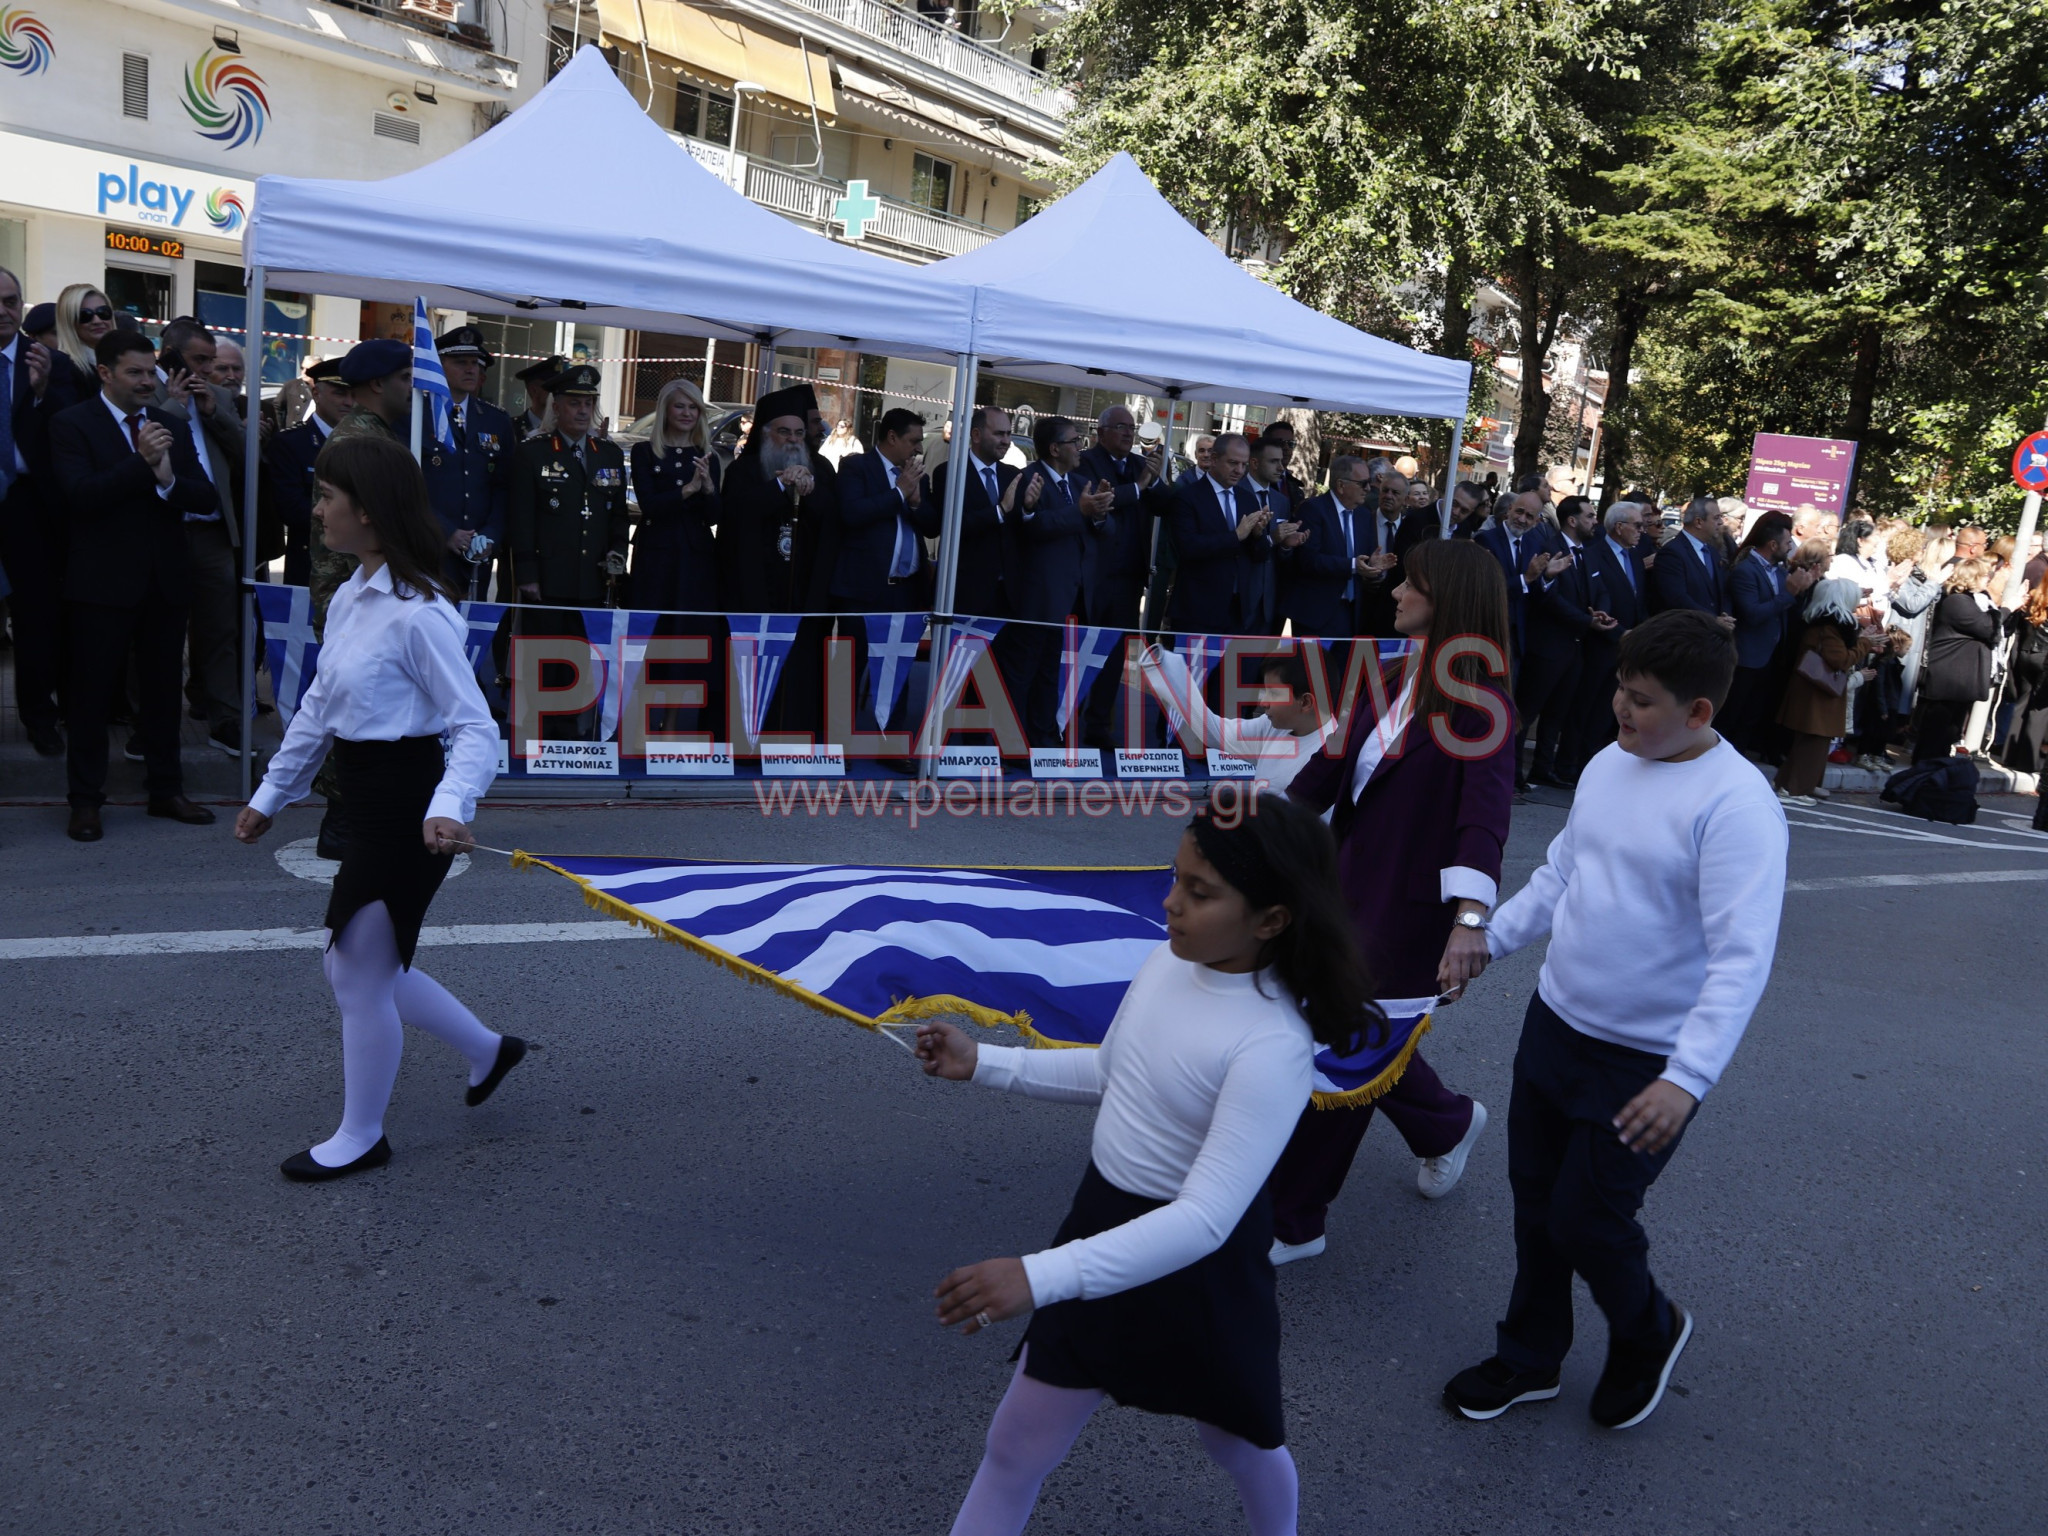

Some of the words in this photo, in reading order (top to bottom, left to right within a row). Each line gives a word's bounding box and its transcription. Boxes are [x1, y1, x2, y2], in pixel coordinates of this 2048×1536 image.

[98, 164, 195, 226] play
[106, 232, 149, 252] 10:00
[538, 745, 607, 755] ΤΑΞΙΑΡΧΟΣ
[649, 753, 730, 764] ΣΤΡΑΤΗΓΟΣ
[764, 754, 841, 765] ΜΗΤΡΟΠΟΛΙΤΗΣ
[939, 755, 999, 766] ΗΜΑΡΧΟΣ
[1119, 753, 1180, 761] ΕΚΠΡΟΣΩΠΟΣ
[533, 759, 613, 769] ΑΣΤΥΝΟΜΙΑΣ
[1033, 758, 1099, 768] ΑΝΤΙΠΕΡΙΦΕΡΕΙΑΡΧΗΣ
[1120, 764, 1181, 773] ΚΥΒΕΡΝΗΣΗΣ
